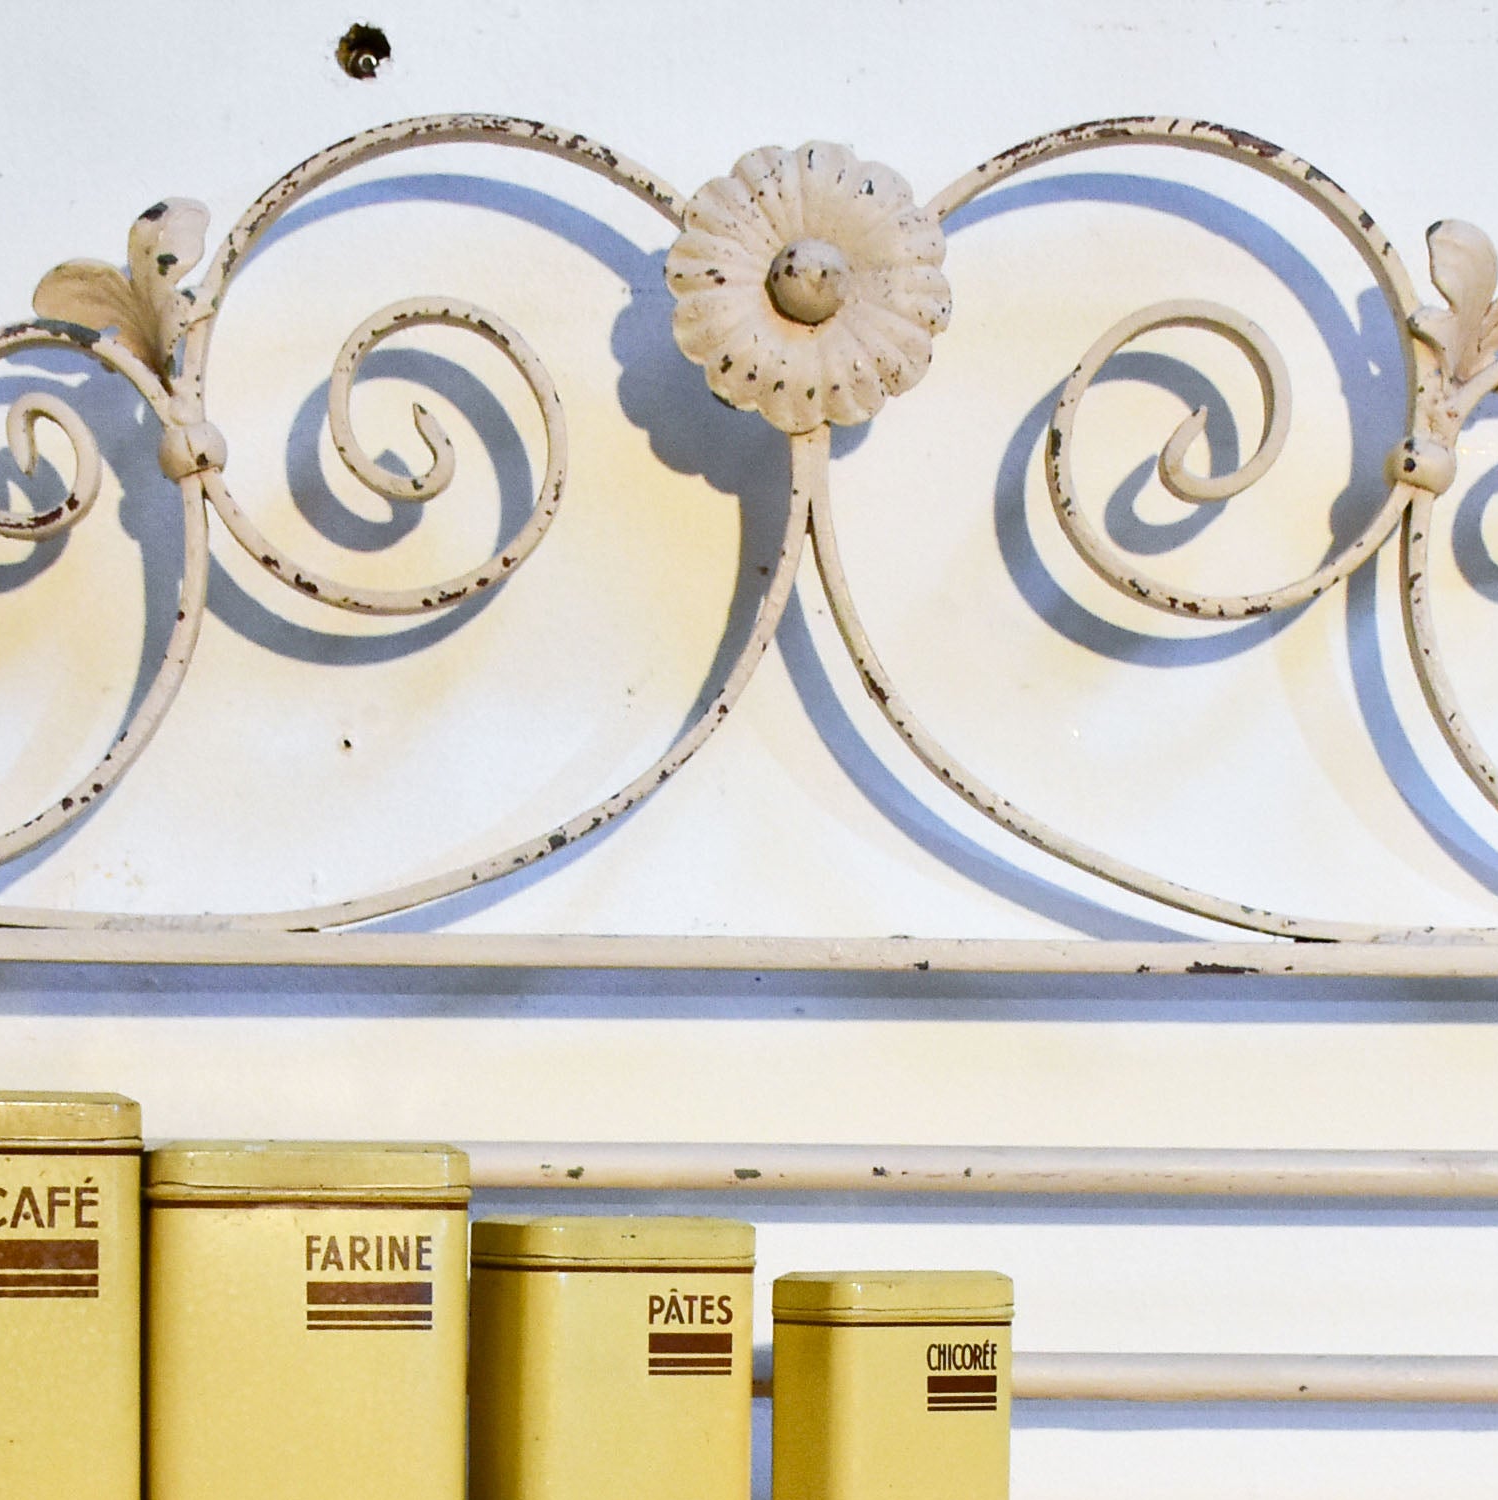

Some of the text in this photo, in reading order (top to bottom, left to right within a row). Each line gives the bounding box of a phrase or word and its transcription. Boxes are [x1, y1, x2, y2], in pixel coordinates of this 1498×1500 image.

[305, 1235, 432, 1271] FARINE
[647, 1288, 733, 1325] PÂTES
[926, 1339, 997, 1371] CHICORÉE
